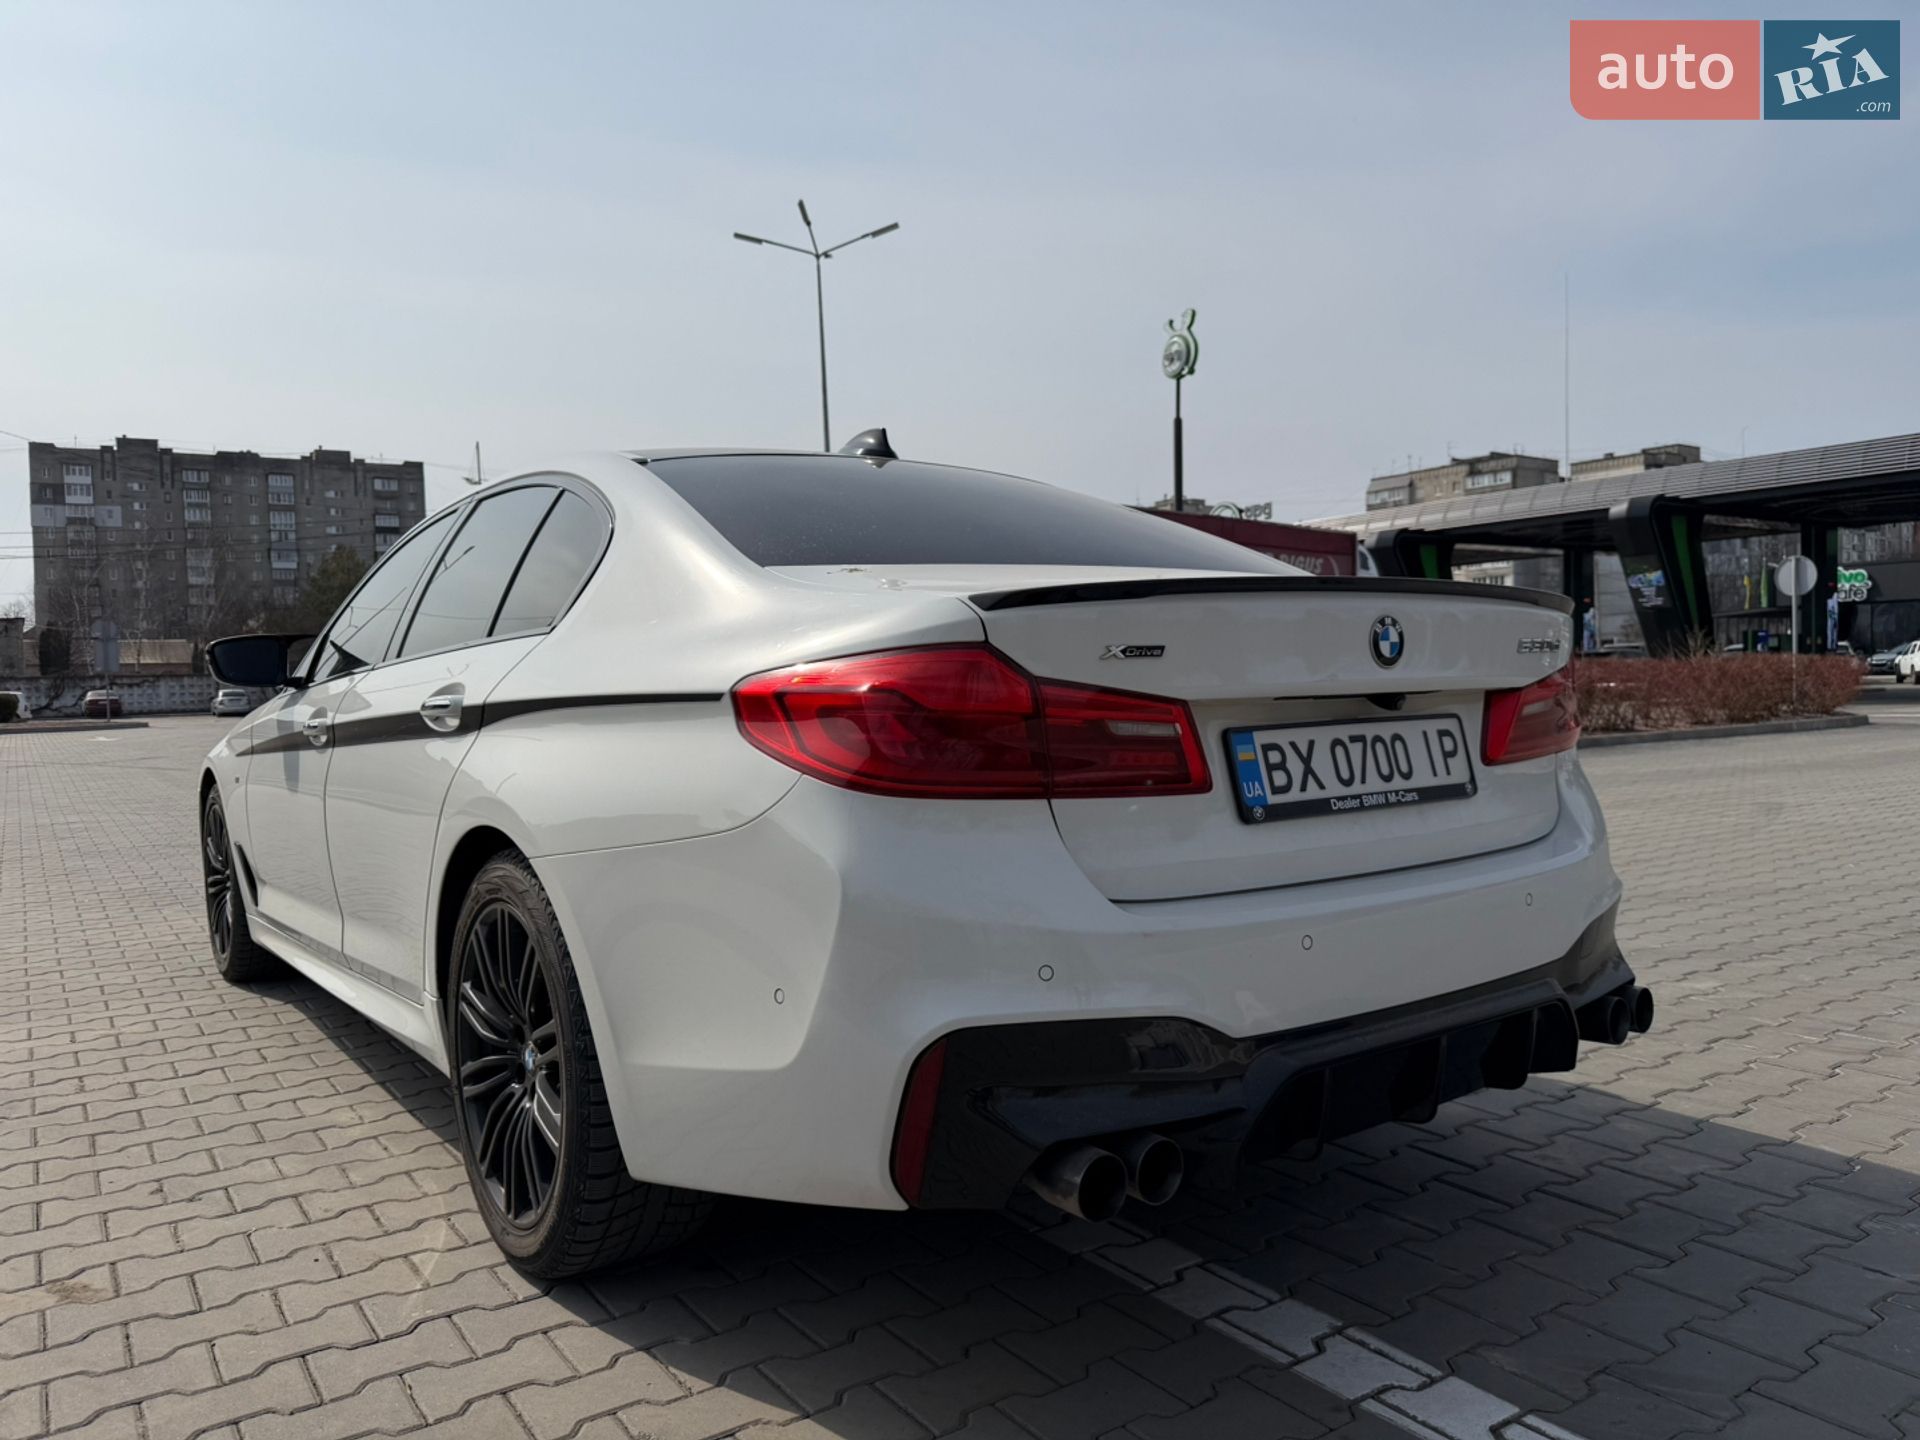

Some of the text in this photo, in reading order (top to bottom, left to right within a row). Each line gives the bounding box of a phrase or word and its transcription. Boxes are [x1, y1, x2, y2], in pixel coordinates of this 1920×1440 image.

[1837, 568, 1867, 584] ivo
[1261, 728, 1459, 796] BX 0700 IP
[1243, 781, 1264, 798] UA
[1330, 797, 1360, 810] Dealer
[1361, 792, 1386, 807] BMW
